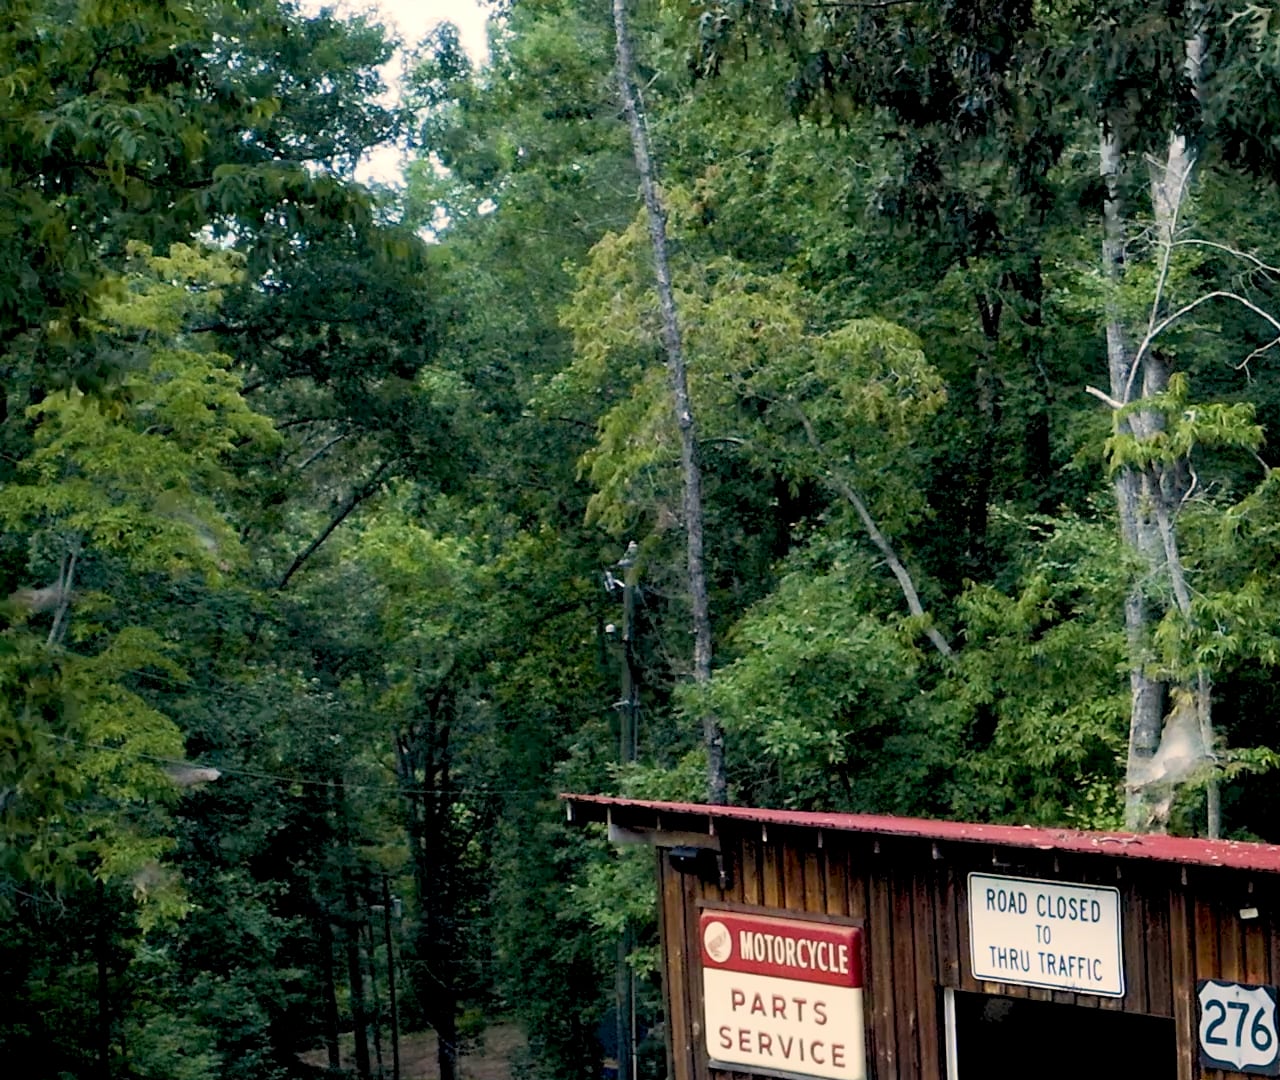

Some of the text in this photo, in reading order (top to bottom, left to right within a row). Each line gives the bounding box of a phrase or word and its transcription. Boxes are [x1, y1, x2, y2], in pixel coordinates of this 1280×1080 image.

[986, 888, 1101, 922] ROAD CLOSED
[739, 930, 849, 975] MOTORCYCLE
[1035, 925, 1051, 944] TO
[989, 946, 1103, 981] THRU TRAFFIC
[731, 988, 828, 1026] PARTS
[1205, 999, 1272, 1052] 276
[719, 1026, 846, 1068] SERVICE
